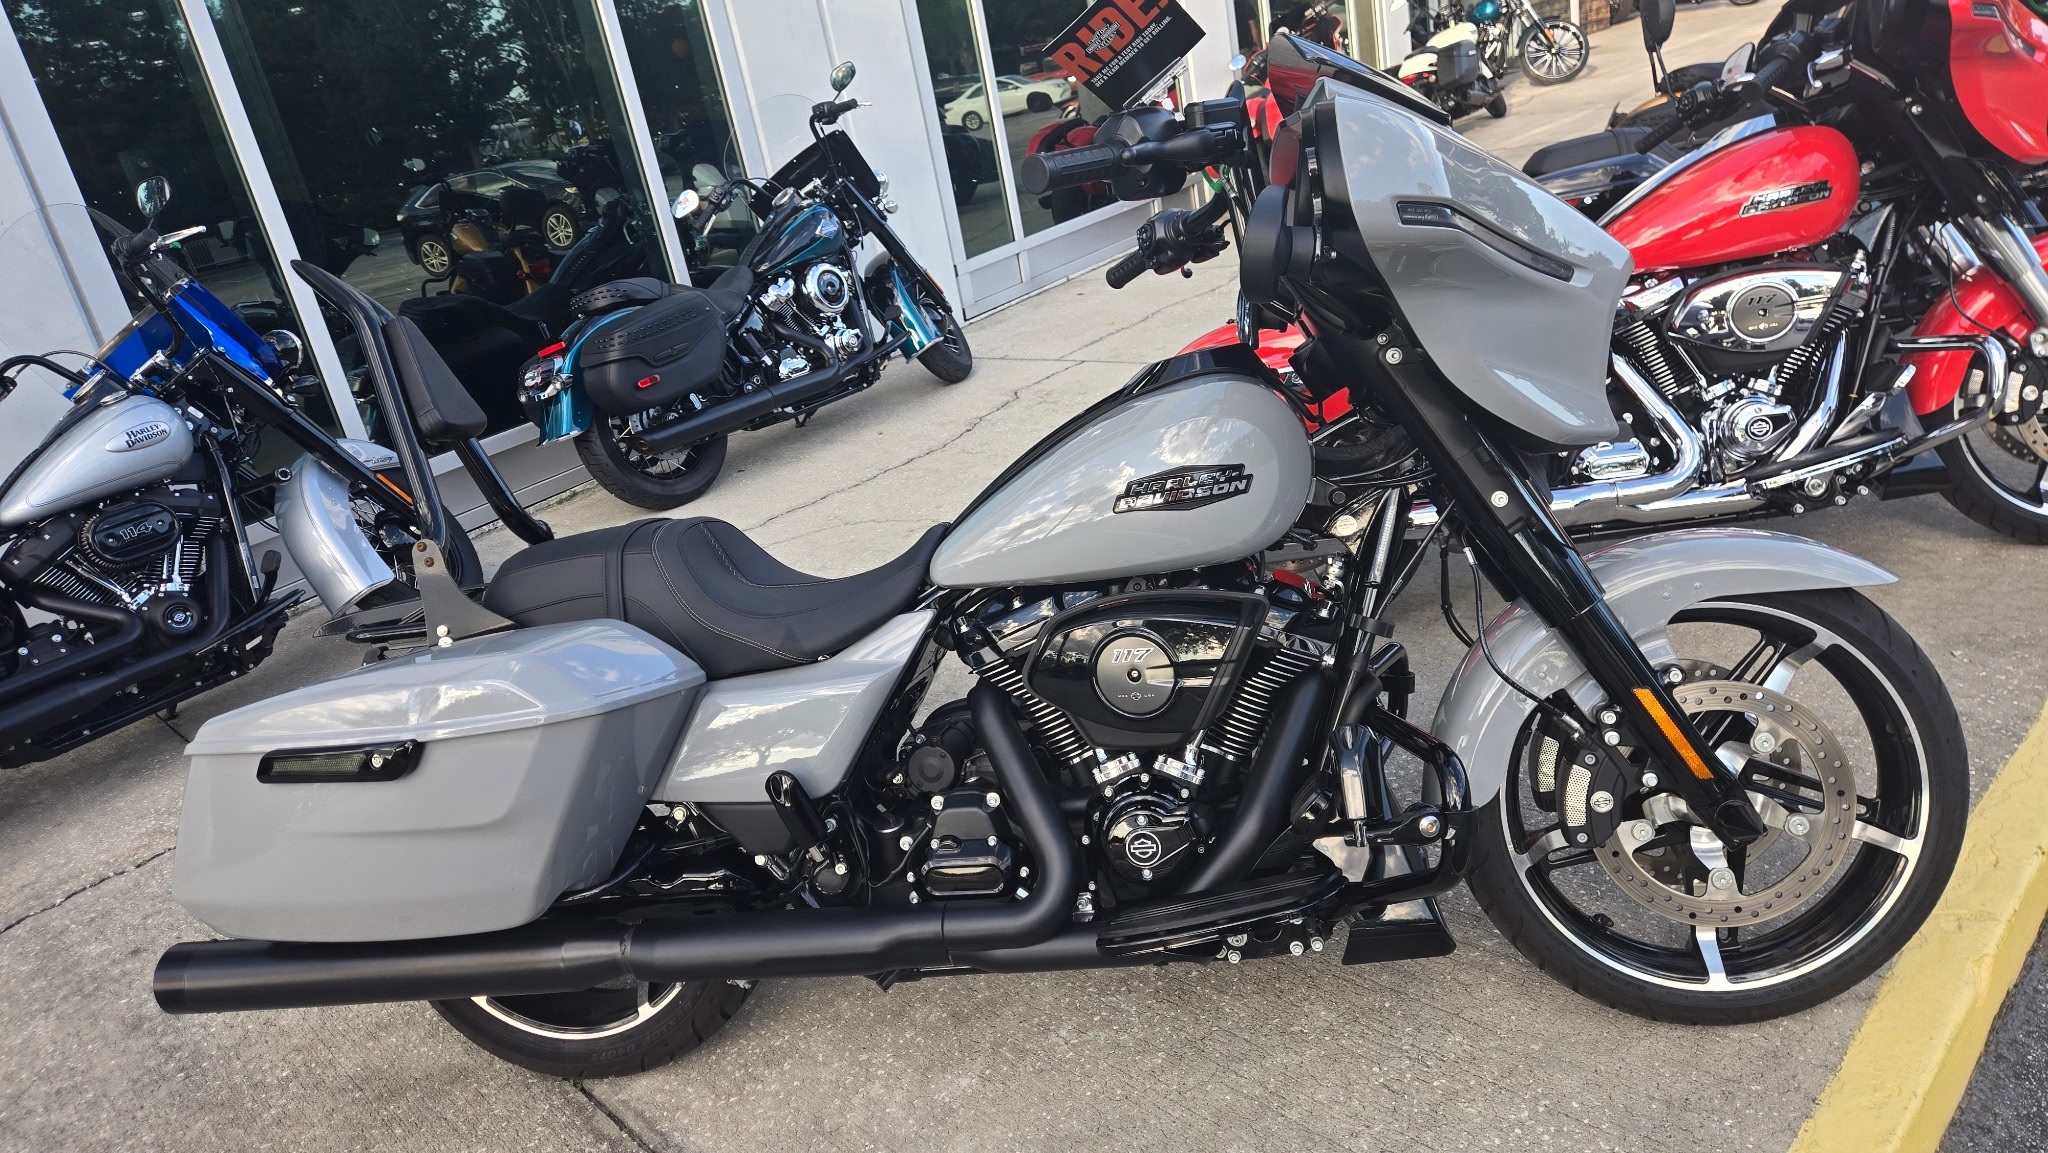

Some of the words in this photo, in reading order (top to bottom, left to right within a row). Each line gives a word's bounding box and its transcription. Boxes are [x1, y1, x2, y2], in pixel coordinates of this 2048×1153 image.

[1091, 72, 1103, 84] TAKE
[1101, 66, 1110, 74] ME
[1108, 58, 1119, 68] FOR
[1120, 45, 1133, 57] TEST
[1131, 35, 1144, 47] RIDE
[1141, 21, 1158, 37] TODAY.
[1095, 78, 1105, 88] SEE
[1106, 64, 1120, 77] TEAM
[1118, 47, 1139, 66] MEMBER
[1143, 34, 1153, 44] GET
[1151, 14, 1173, 36] ROLLING.
[1747, 293, 1779, 307] 117
[125, 428, 168, 448] DAVIDSON
[1118, 479, 1248, 509] DAVIDSON
[120, 522, 152, 540] 114
[1112, 647, 1155, 664] 117
